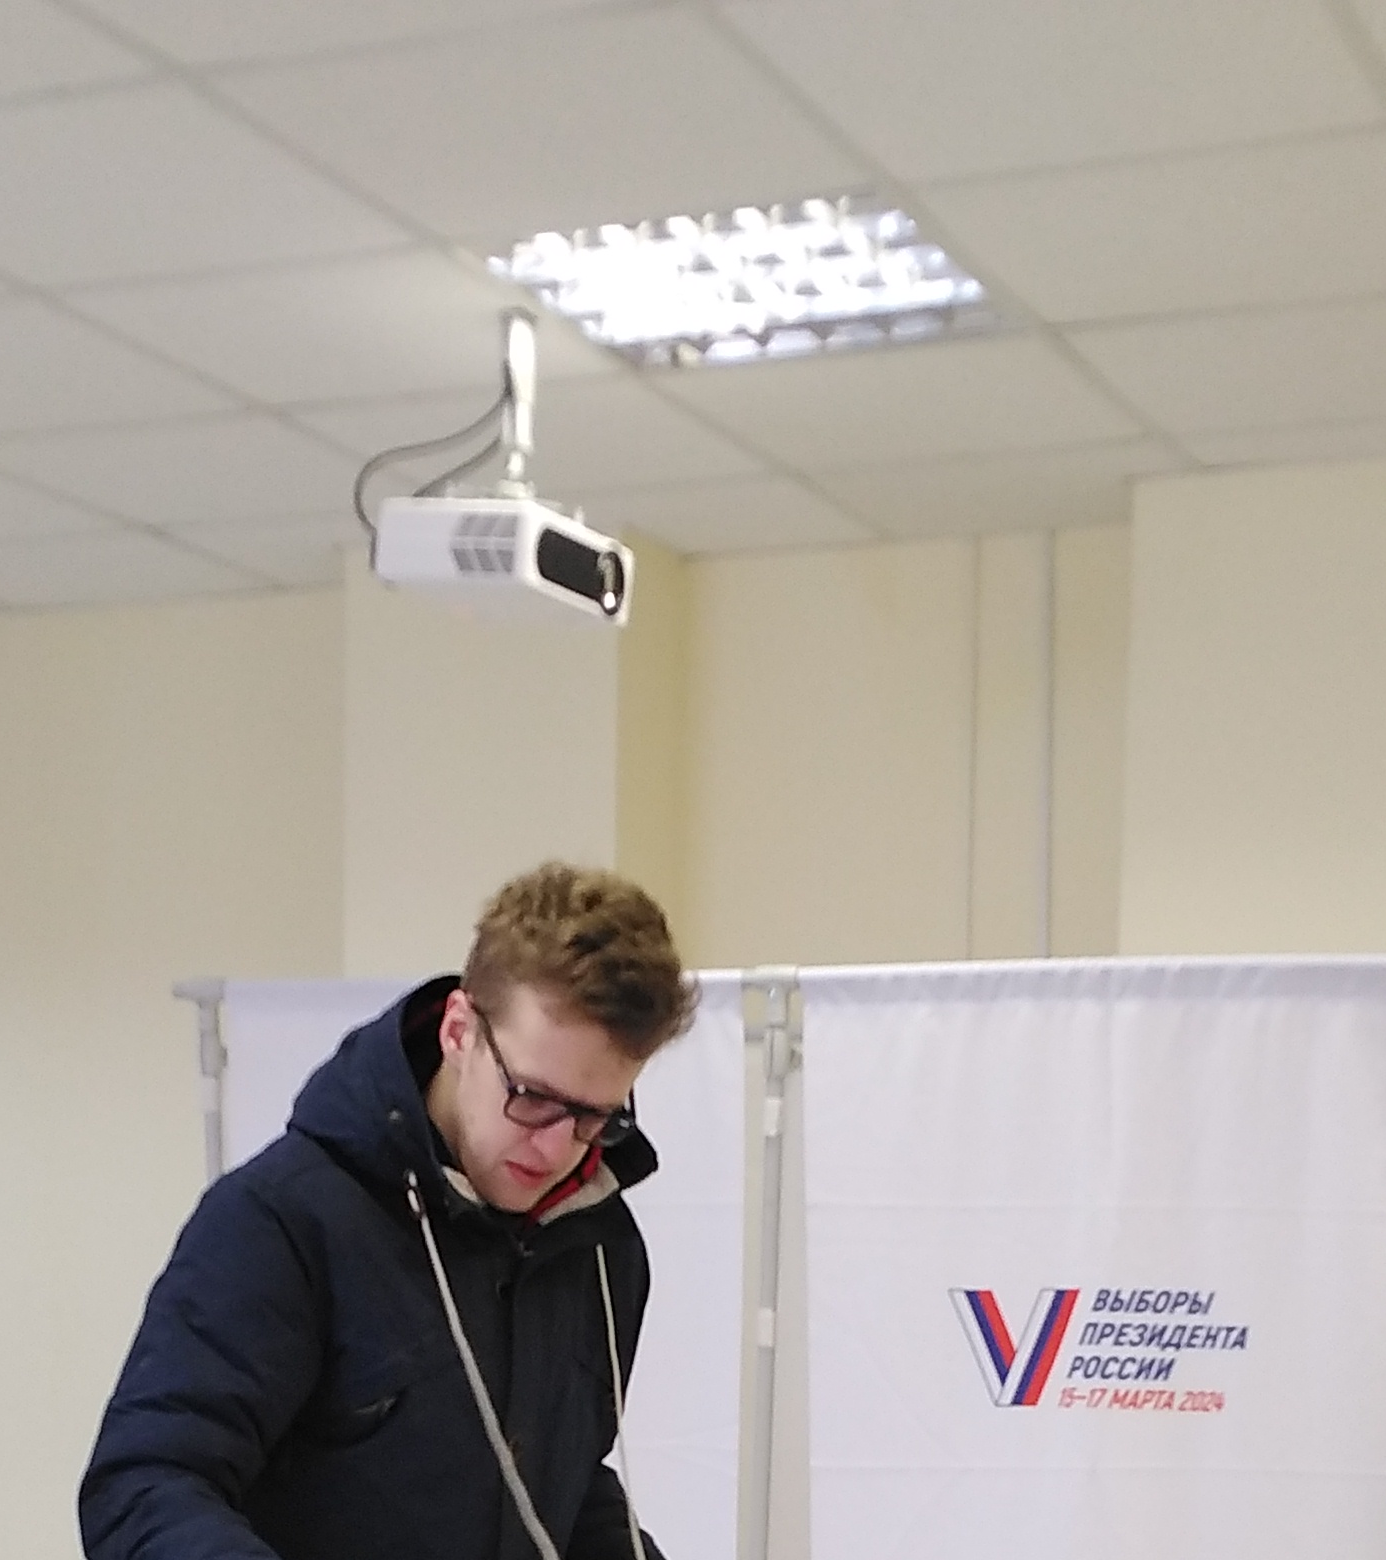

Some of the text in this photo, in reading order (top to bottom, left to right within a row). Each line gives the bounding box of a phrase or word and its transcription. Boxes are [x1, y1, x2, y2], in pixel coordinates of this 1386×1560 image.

[1091, 1288, 1215, 1316] ВЫБОРЫ
[1078, 1321, 1251, 1351] ПРЕЗИДЕНТА
[1067, 1355, 1176, 1381] РОССИИ
[1107, 1388, 1175, 1410] МАРТА
[1178, 1390, 1225, 1412] 2024
